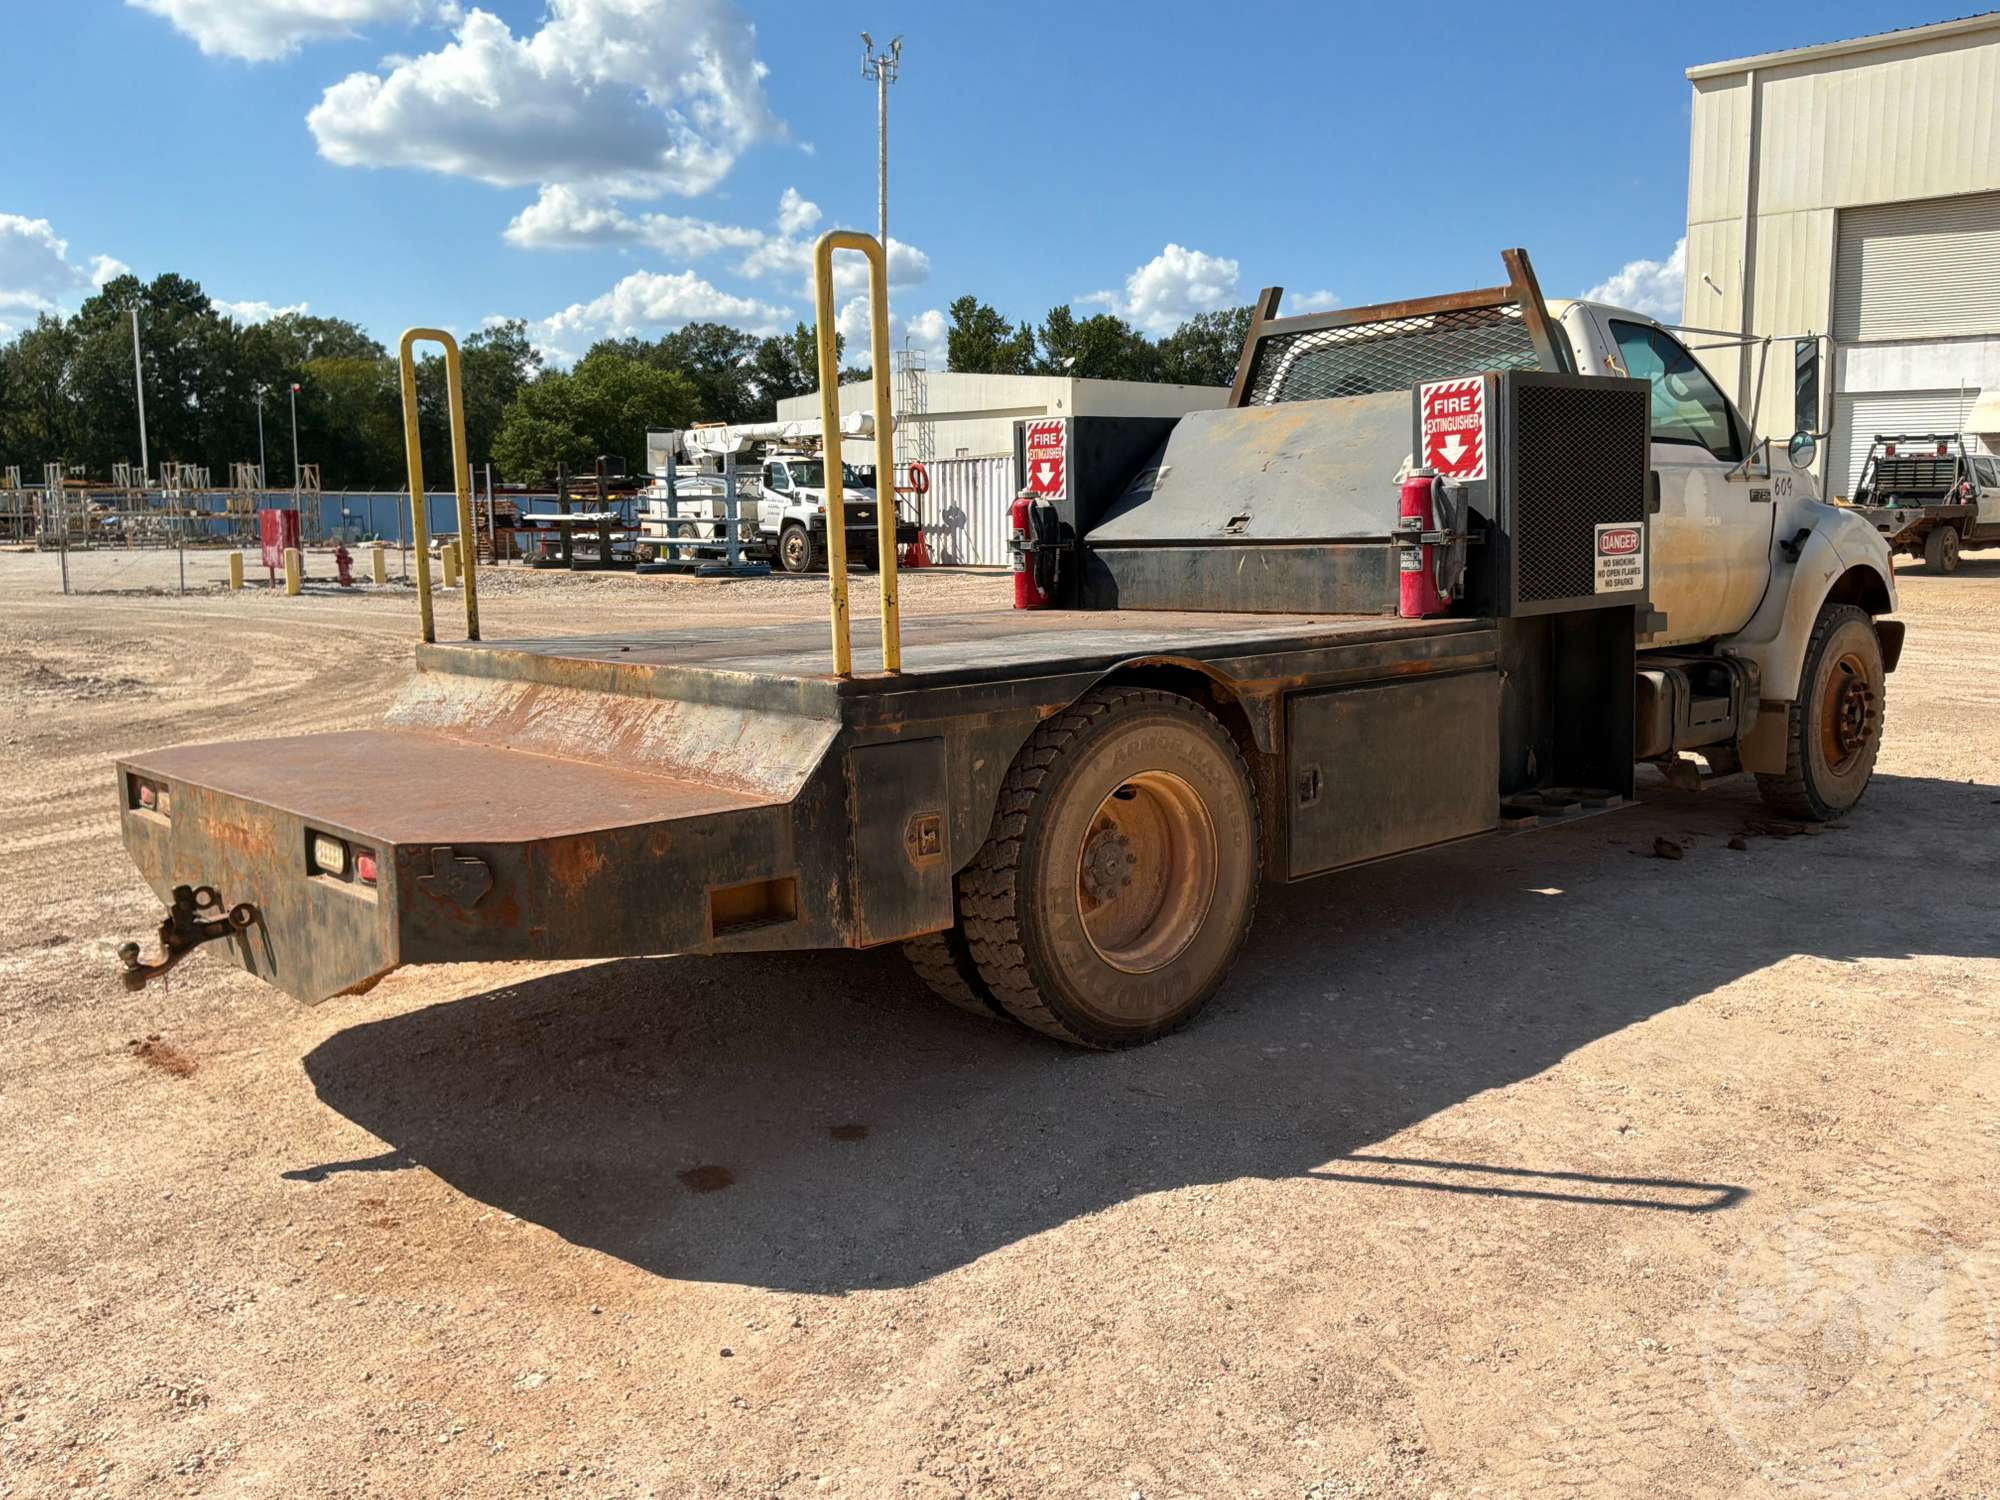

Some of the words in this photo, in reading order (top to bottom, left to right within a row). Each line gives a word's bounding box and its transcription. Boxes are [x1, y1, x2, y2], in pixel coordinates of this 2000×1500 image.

[1434, 396, 1471, 415] FIRE
[1427, 414, 1479, 433] EXTINGUISHER
[1034, 433, 1057, 446] FIRE
[1029, 447, 1062, 460] EXTINGUISHER
[1775, 476, 1793, 496] 609
[1603, 534, 1637, 549] DANGER
[1612, 558, 1636, 567] SMOKING
[1598, 570, 1605, 578] NO
[1606, 569, 1620, 577] OPEN
[1622, 567, 1641, 576] FLAMES
[1614, 577, 1634, 587] SPARKS
[1112, 734, 1185, 768] ARMOR
